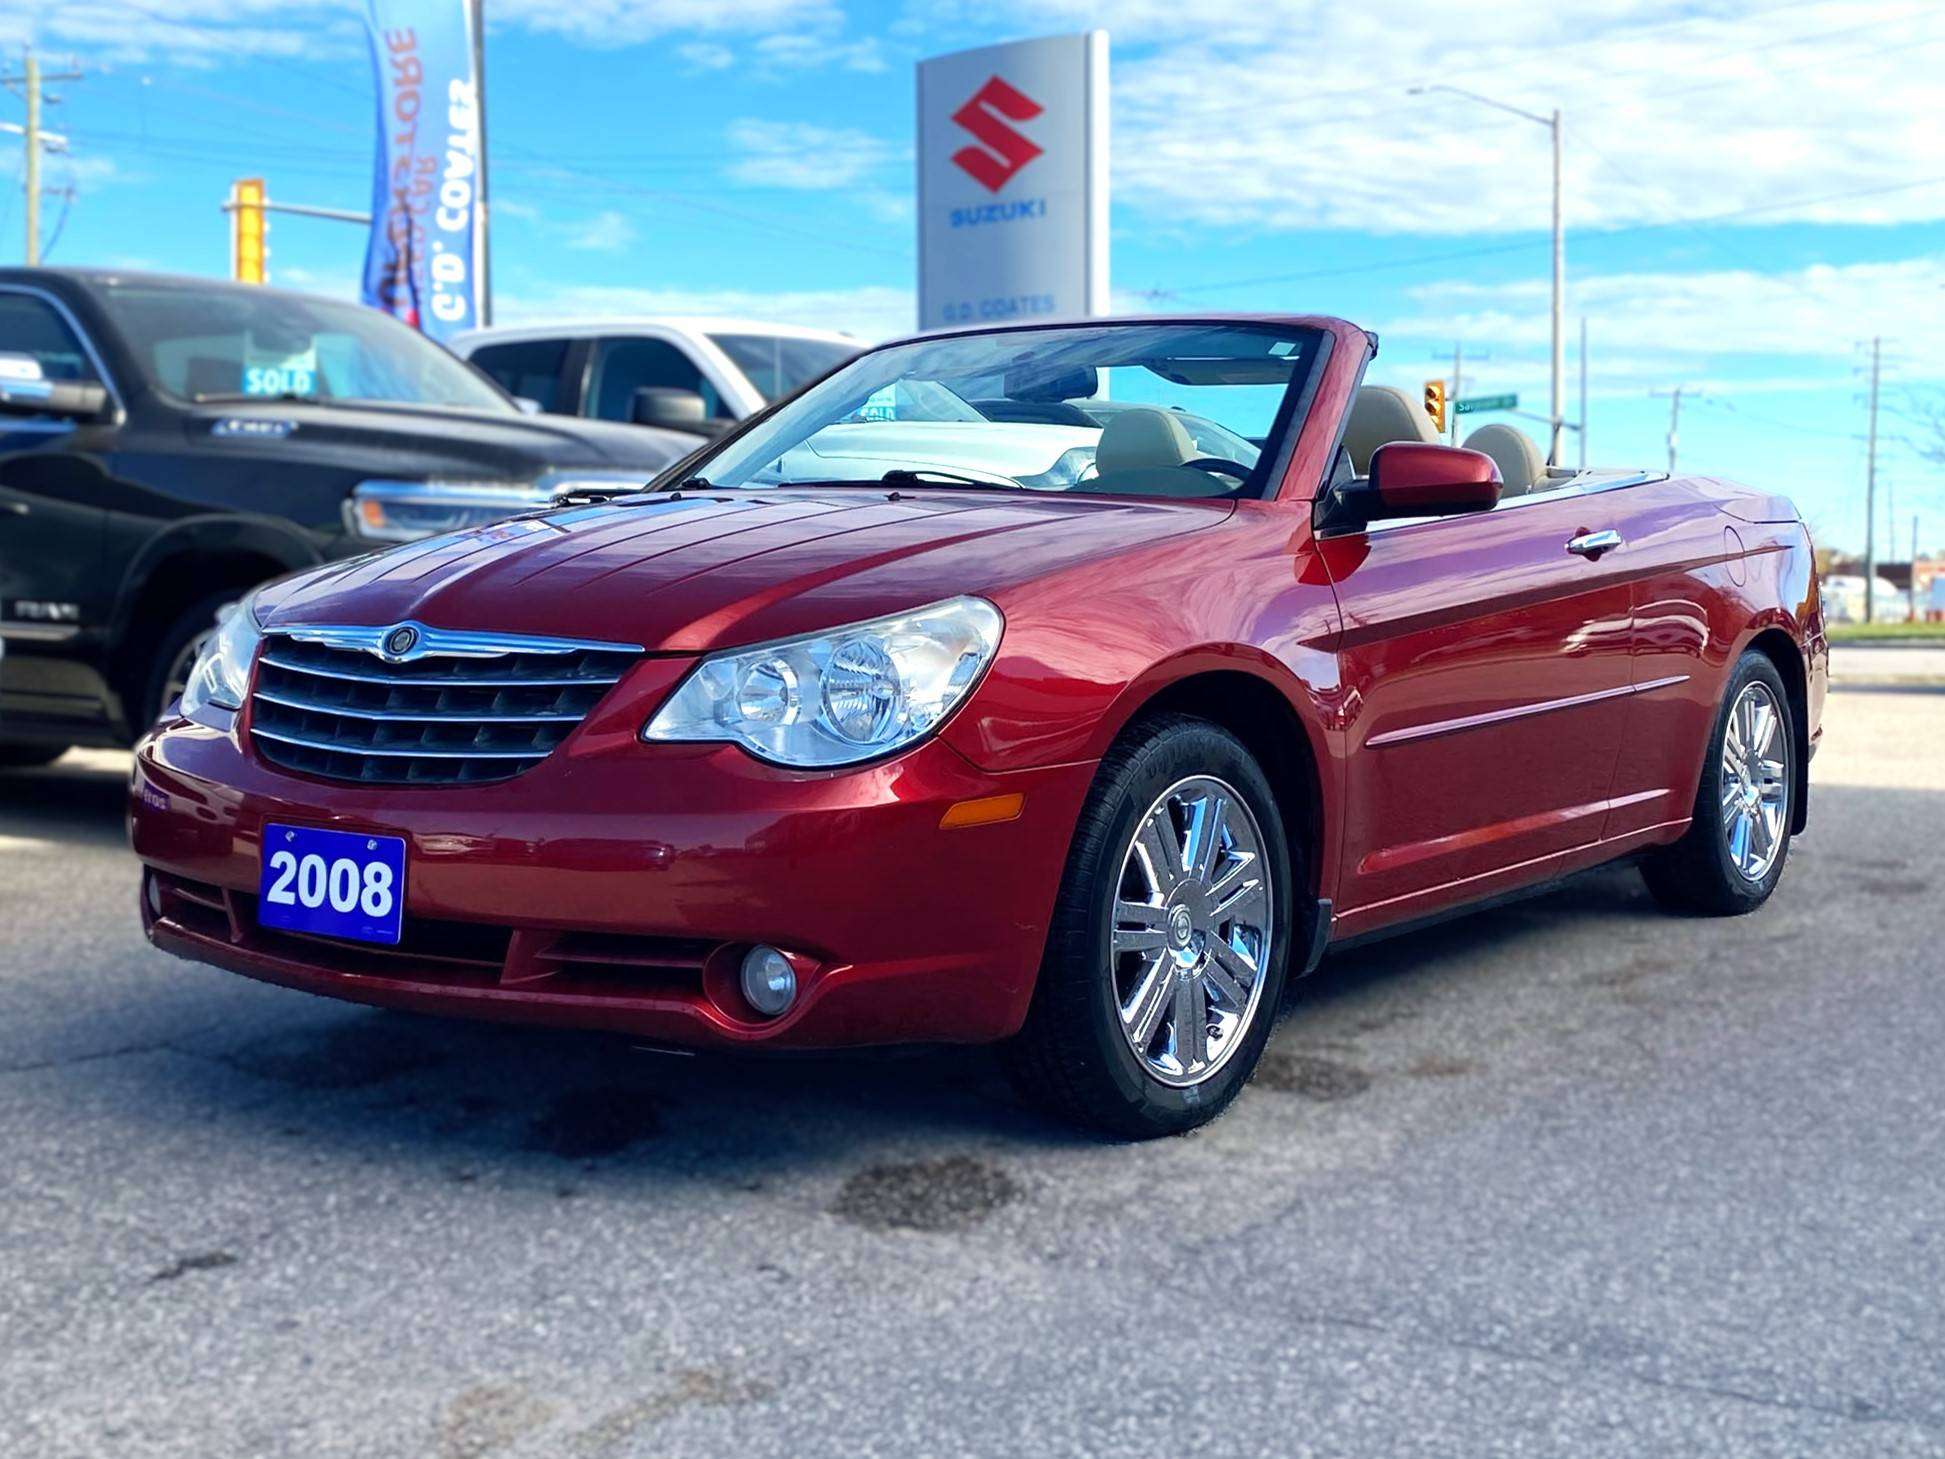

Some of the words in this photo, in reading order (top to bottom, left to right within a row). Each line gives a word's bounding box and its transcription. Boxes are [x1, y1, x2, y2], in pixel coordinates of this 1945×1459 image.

[950, 199, 1046, 228] SUZUKI
[246, 367, 312, 396] SOLD
[267, 851, 393, 917] 2008
